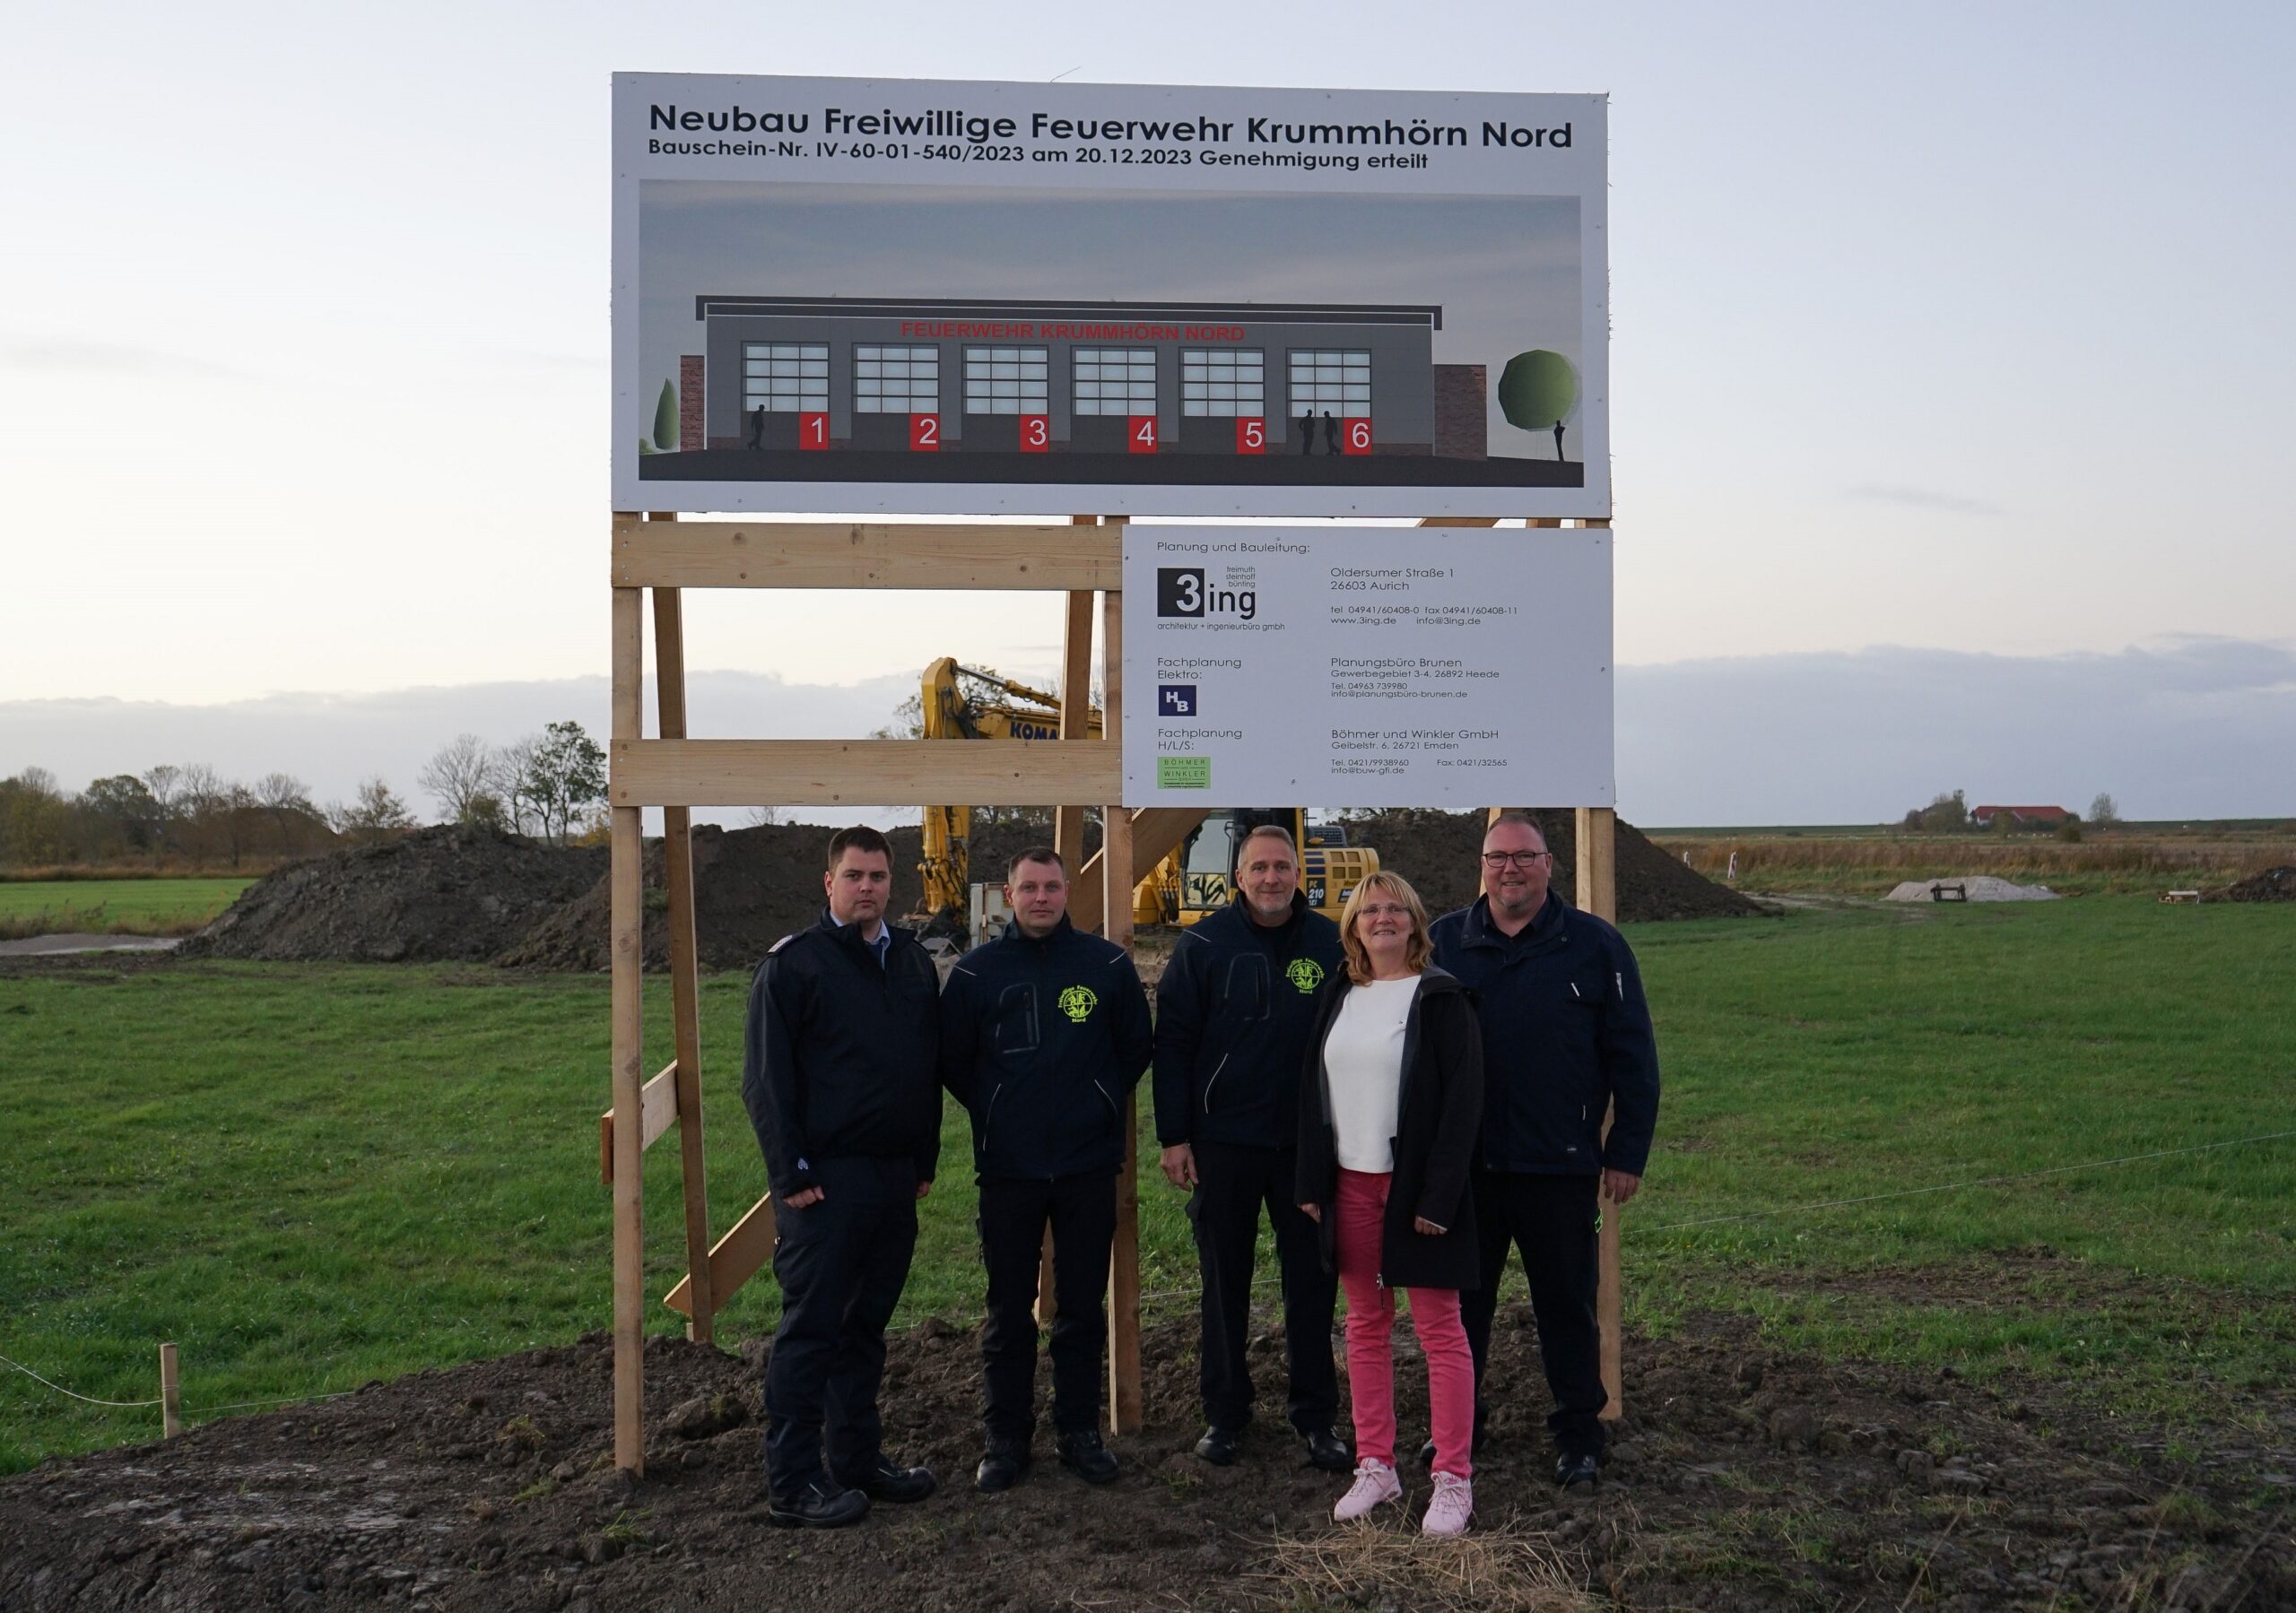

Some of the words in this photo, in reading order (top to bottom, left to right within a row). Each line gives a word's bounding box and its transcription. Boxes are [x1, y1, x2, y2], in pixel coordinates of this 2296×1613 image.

[651, 105, 808, 133] Neubau
[826, 108, 1016, 143] Freiwillige
[1032, 113, 1234, 142] Feuerwehr
[1248, 117, 1466, 145] Krummhörn
[1483, 122, 1571, 147] Nord
[649, 139, 807, 157] Bauschein-Nr.
[817, 143, 1023, 162] IV-60-01-540/2023
[1032, 151, 1067, 161] am
[1076, 148, 1191, 164] 20.12.2023
[1200, 151, 1359, 171] Genehmigung
[1368, 153, 1428, 168] erteilt
[900, 322, 1033, 338] FEUERWEHR
[1041, 324, 1178, 340] KRUMMHÖRN
[1185, 325, 1244, 341] NORD
[812, 418, 822, 442] 1
[919, 419, 936, 444] 2
[1030, 420, 1046, 445] 3
[1137, 421, 1154, 446] 4
[1246, 422, 1262, 447] 5
[1352, 423, 1369, 447] 6
[1158, 542, 1208, 553] Planung
[1213, 542, 1236, 551] und
[1241, 543, 1309, 554] Bauleitung:
[1331, 568, 1402, 577] Oldersumer
[1406, 568, 1444, 577] Straße
[1450, 569, 1453, 577] 1
[1331, 581, 1366, 590] 26603
[1370, 581, 1409, 590] Aurich
[1349, 606, 1419, 614] 04941/60408-0
[1331, 617, 1396, 626] www.3ing.de
[1417, 617, 1481, 626] info@3ing.de
[1207, 623, 1260, 631] ingenieurbüro
[1158, 658, 1241, 669] Fachplanung
[1332, 658, 1415, 669] Planungsbüro
[1420, 658, 1462, 667] Brunen
[1158, 670, 1202, 679] Elektro:
[1331, 670, 1411, 679] Gewerbegebiet
[1332, 689, 1467, 698] info@planungsbüro-brunen.de
[1010, 722, 1060, 740] KOMA
[1159, 729, 1241, 740] Fachplanung
[1332, 730, 1379, 739] Böhmer
[1384, 730, 1406, 739] und
[1412, 730, 1455, 739] Winkler
[1459, 730, 1498, 739] GmbH
[1159, 741, 1194, 750] H/L/S:
[1309, 889, 1324, 898] 210
